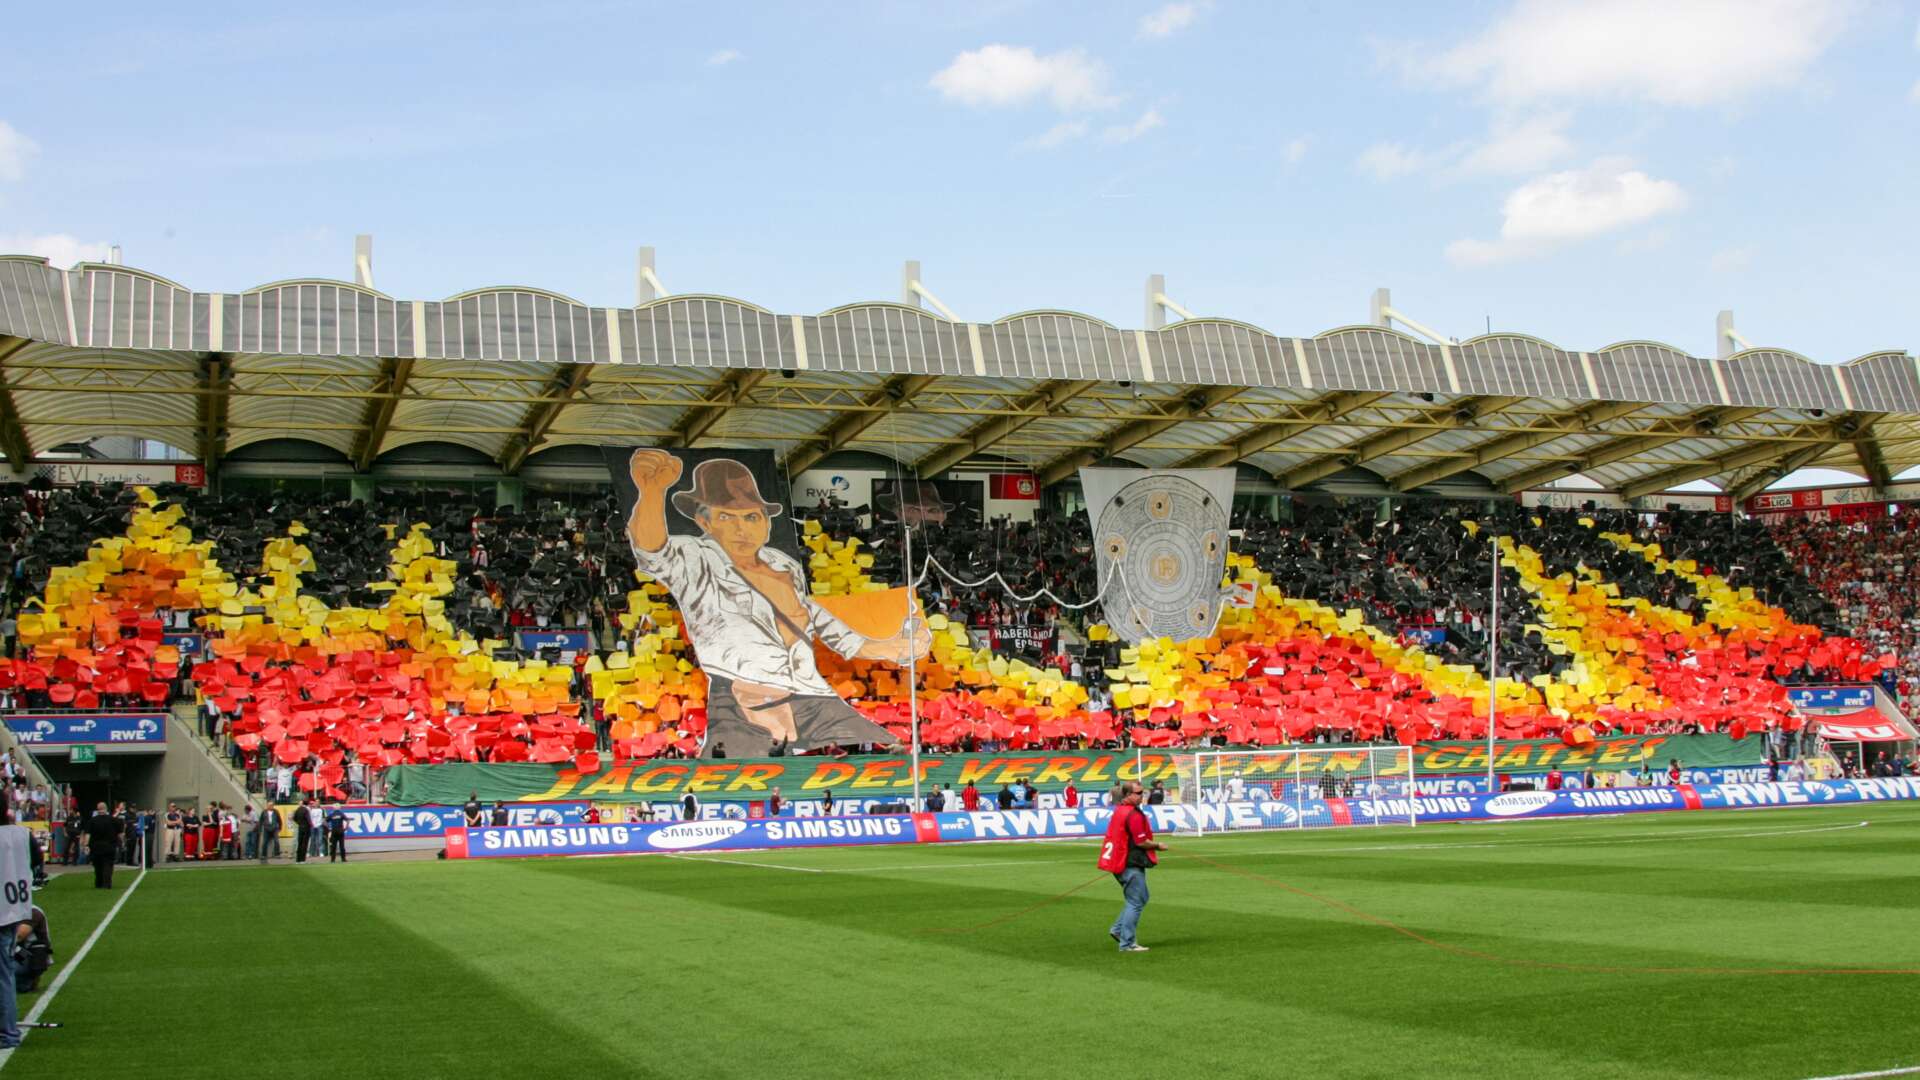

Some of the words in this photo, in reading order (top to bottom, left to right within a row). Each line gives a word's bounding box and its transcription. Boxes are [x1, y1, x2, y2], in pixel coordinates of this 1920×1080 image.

[1772, 499, 1792, 507] LIGA
[17, 732, 43, 742] WE
[111, 730, 146, 741] RWE
[518, 760, 785, 801] JÄGER
[801, 760, 943, 790] DES
[1723, 768, 1770, 785] RWE
[1494, 795, 1550, 807] SAMSUNG
[1569, 788, 1675, 808] SAMSUNG
[1717, 781, 1809, 806] RWE
[1151, 801, 1263, 831] RWE
[1358, 797, 1472, 817] SAMSUNG
[661, 826, 737, 838] SAMSUNG
[766, 817, 902, 840] SAMSUNG
[969, 808, 1087, 837] RWE
[483, 826, 630, 849] SAMSUNG
[1102, 842, 1114, 860] 2
[4, 880, 29, 904] 08
